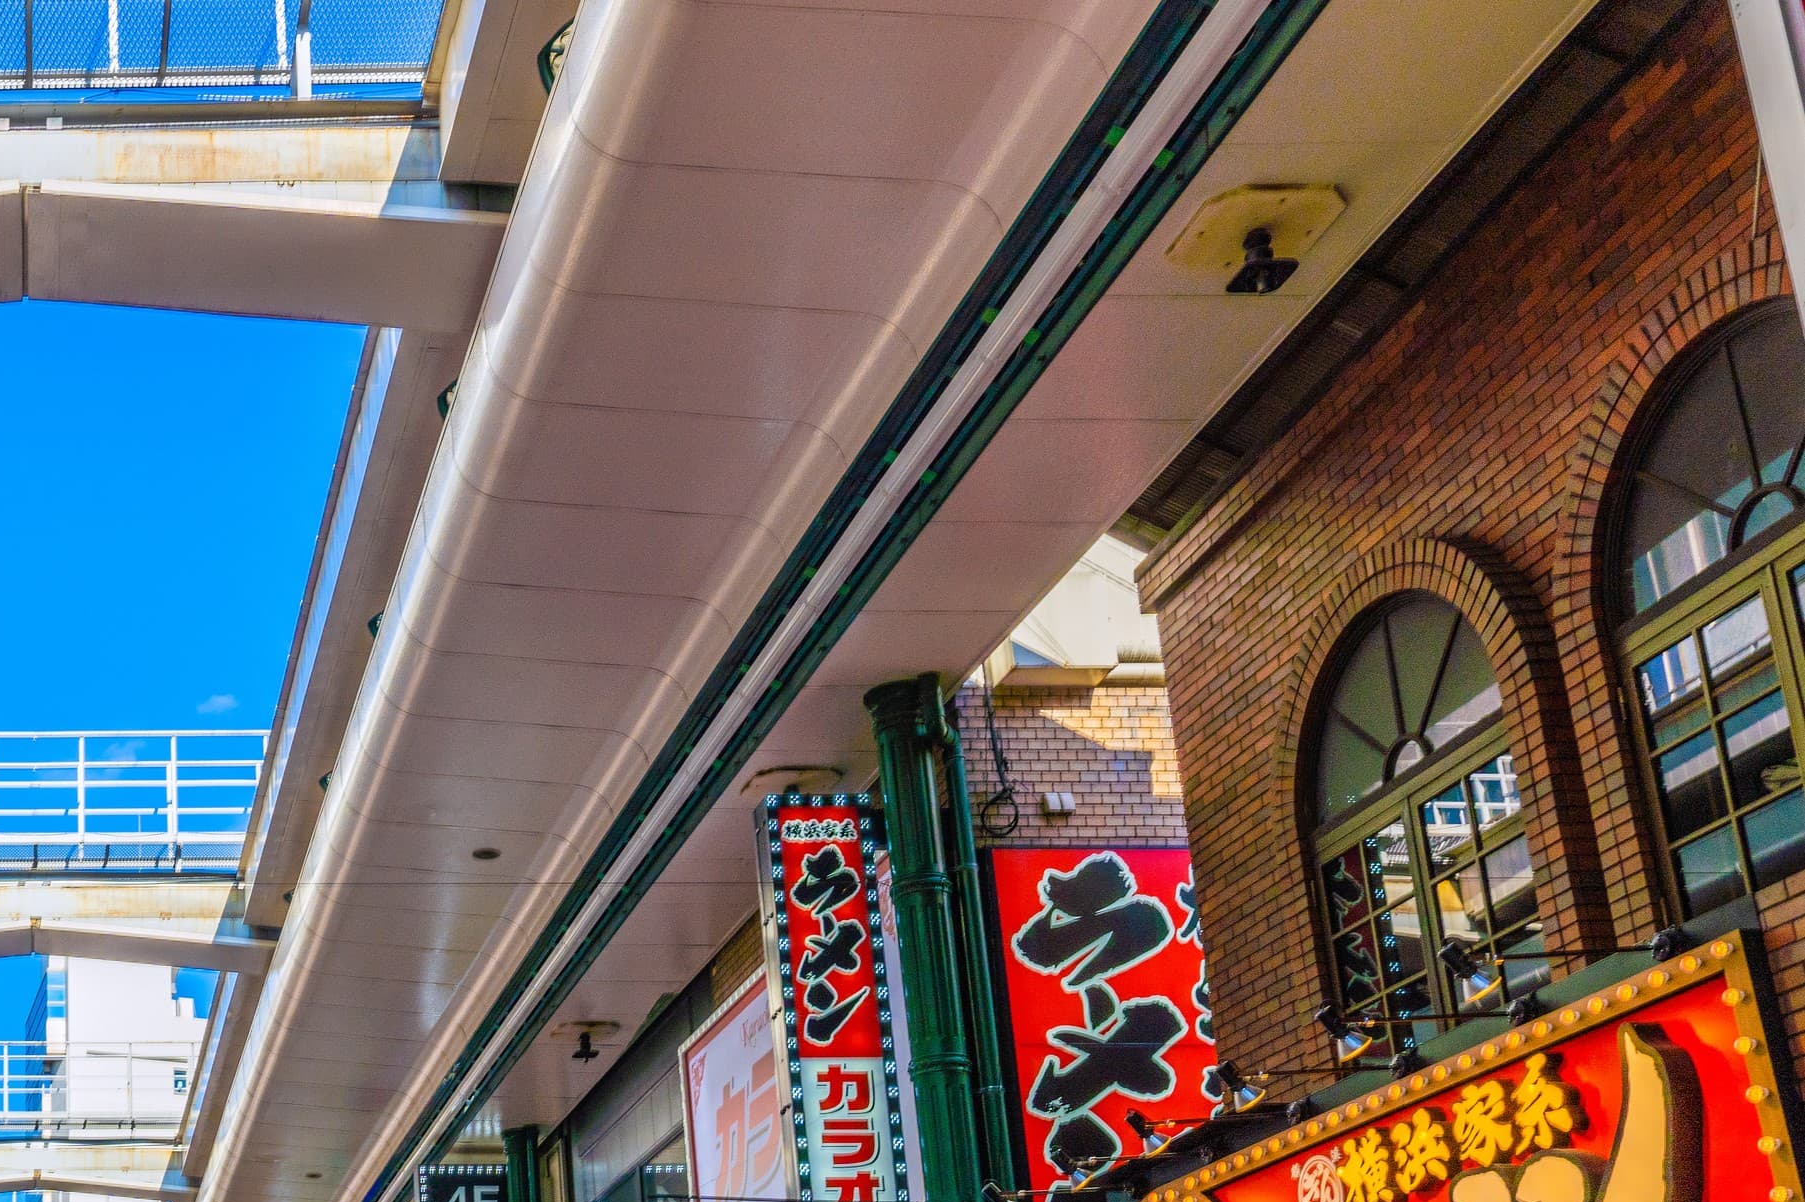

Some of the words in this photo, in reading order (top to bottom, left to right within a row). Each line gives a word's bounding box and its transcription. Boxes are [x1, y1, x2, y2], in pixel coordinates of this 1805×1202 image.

[782, 819, 858, 842] 横浜家系
[789, 842, 872, 1047] ラーメン
